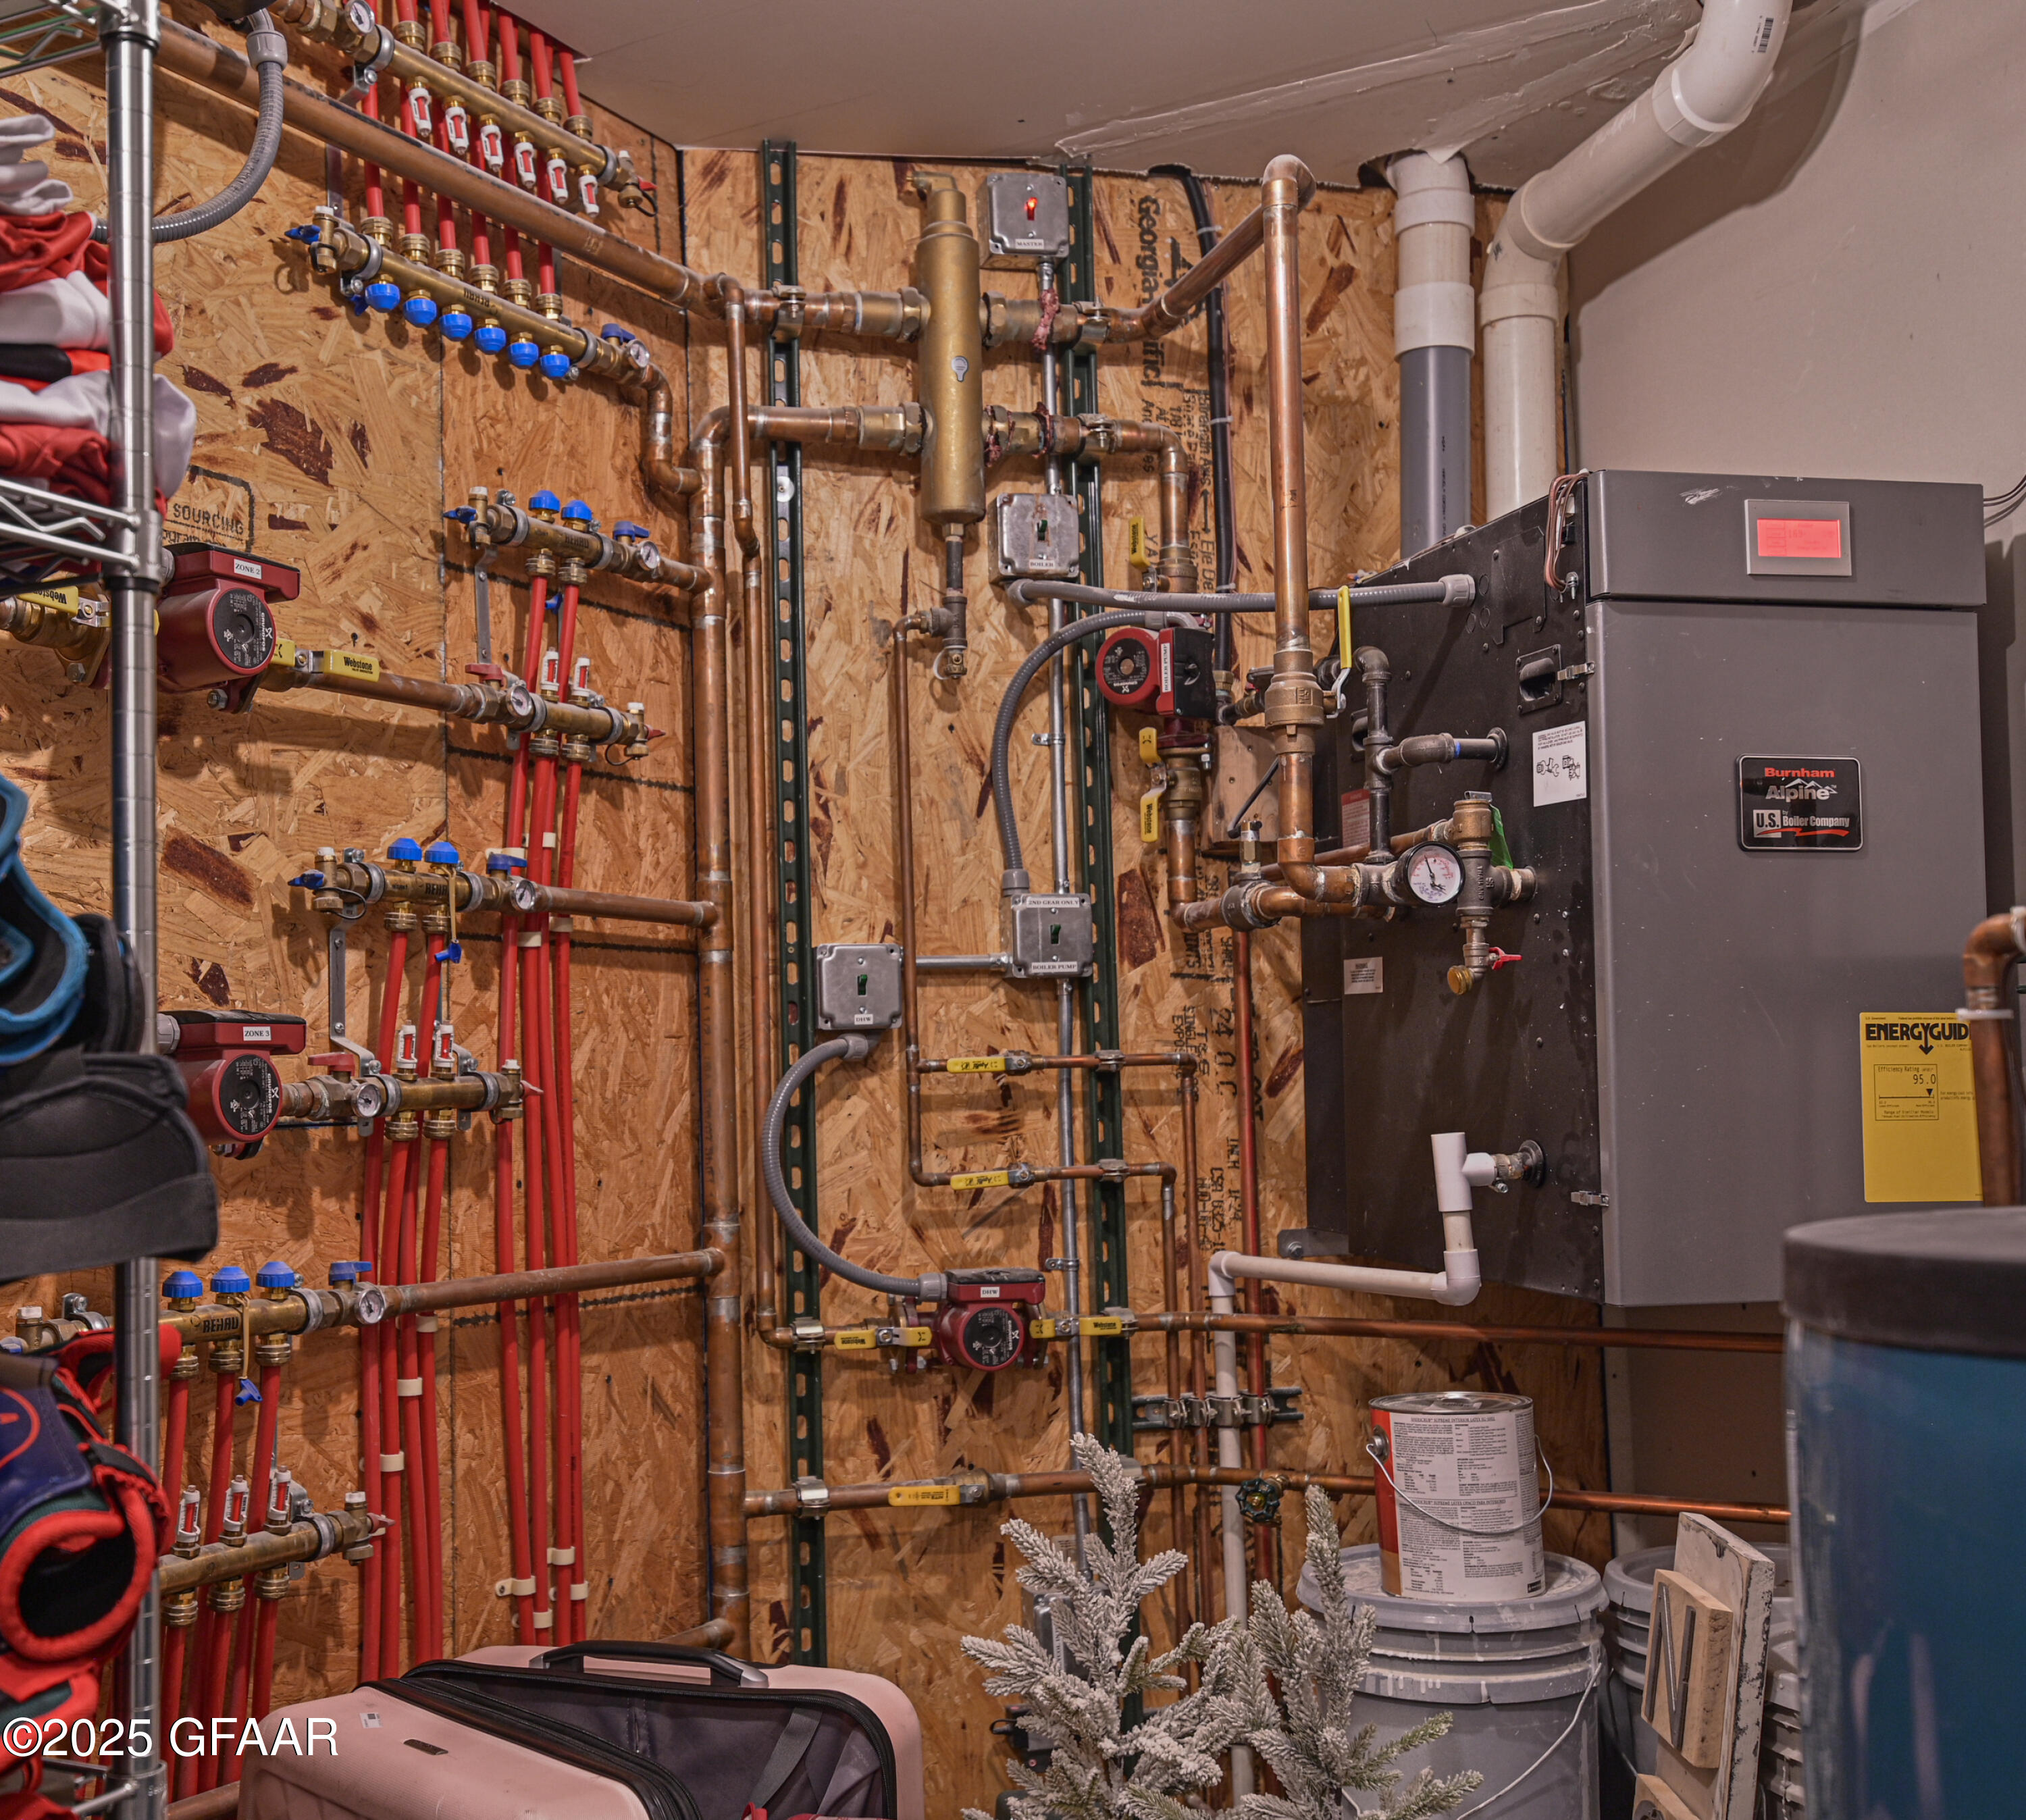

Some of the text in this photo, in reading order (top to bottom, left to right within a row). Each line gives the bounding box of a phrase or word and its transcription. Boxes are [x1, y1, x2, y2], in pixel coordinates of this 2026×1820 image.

[173, 503, 244, 535] SOURCING
[235, 563, 255, 574] ZONE
[343, 656, 373, 671] Webstone
[1764, 767, 1836, 778] Burnham
[1765, 785, 1831, 803] Alpine
[1145, 803, 1153, 834] Webstone
[1756, 812, 1780, 828] U.S.
[1783, 816, 1850, 828] Boiler Company
[1865, 1023, 1971, 1041] ENERGYGUID
[1913, 1074, 1936, 1085] 95.0
[203, 1316, 240, 1333] REHAU
[1645, 1582, 1696, 1752] N
